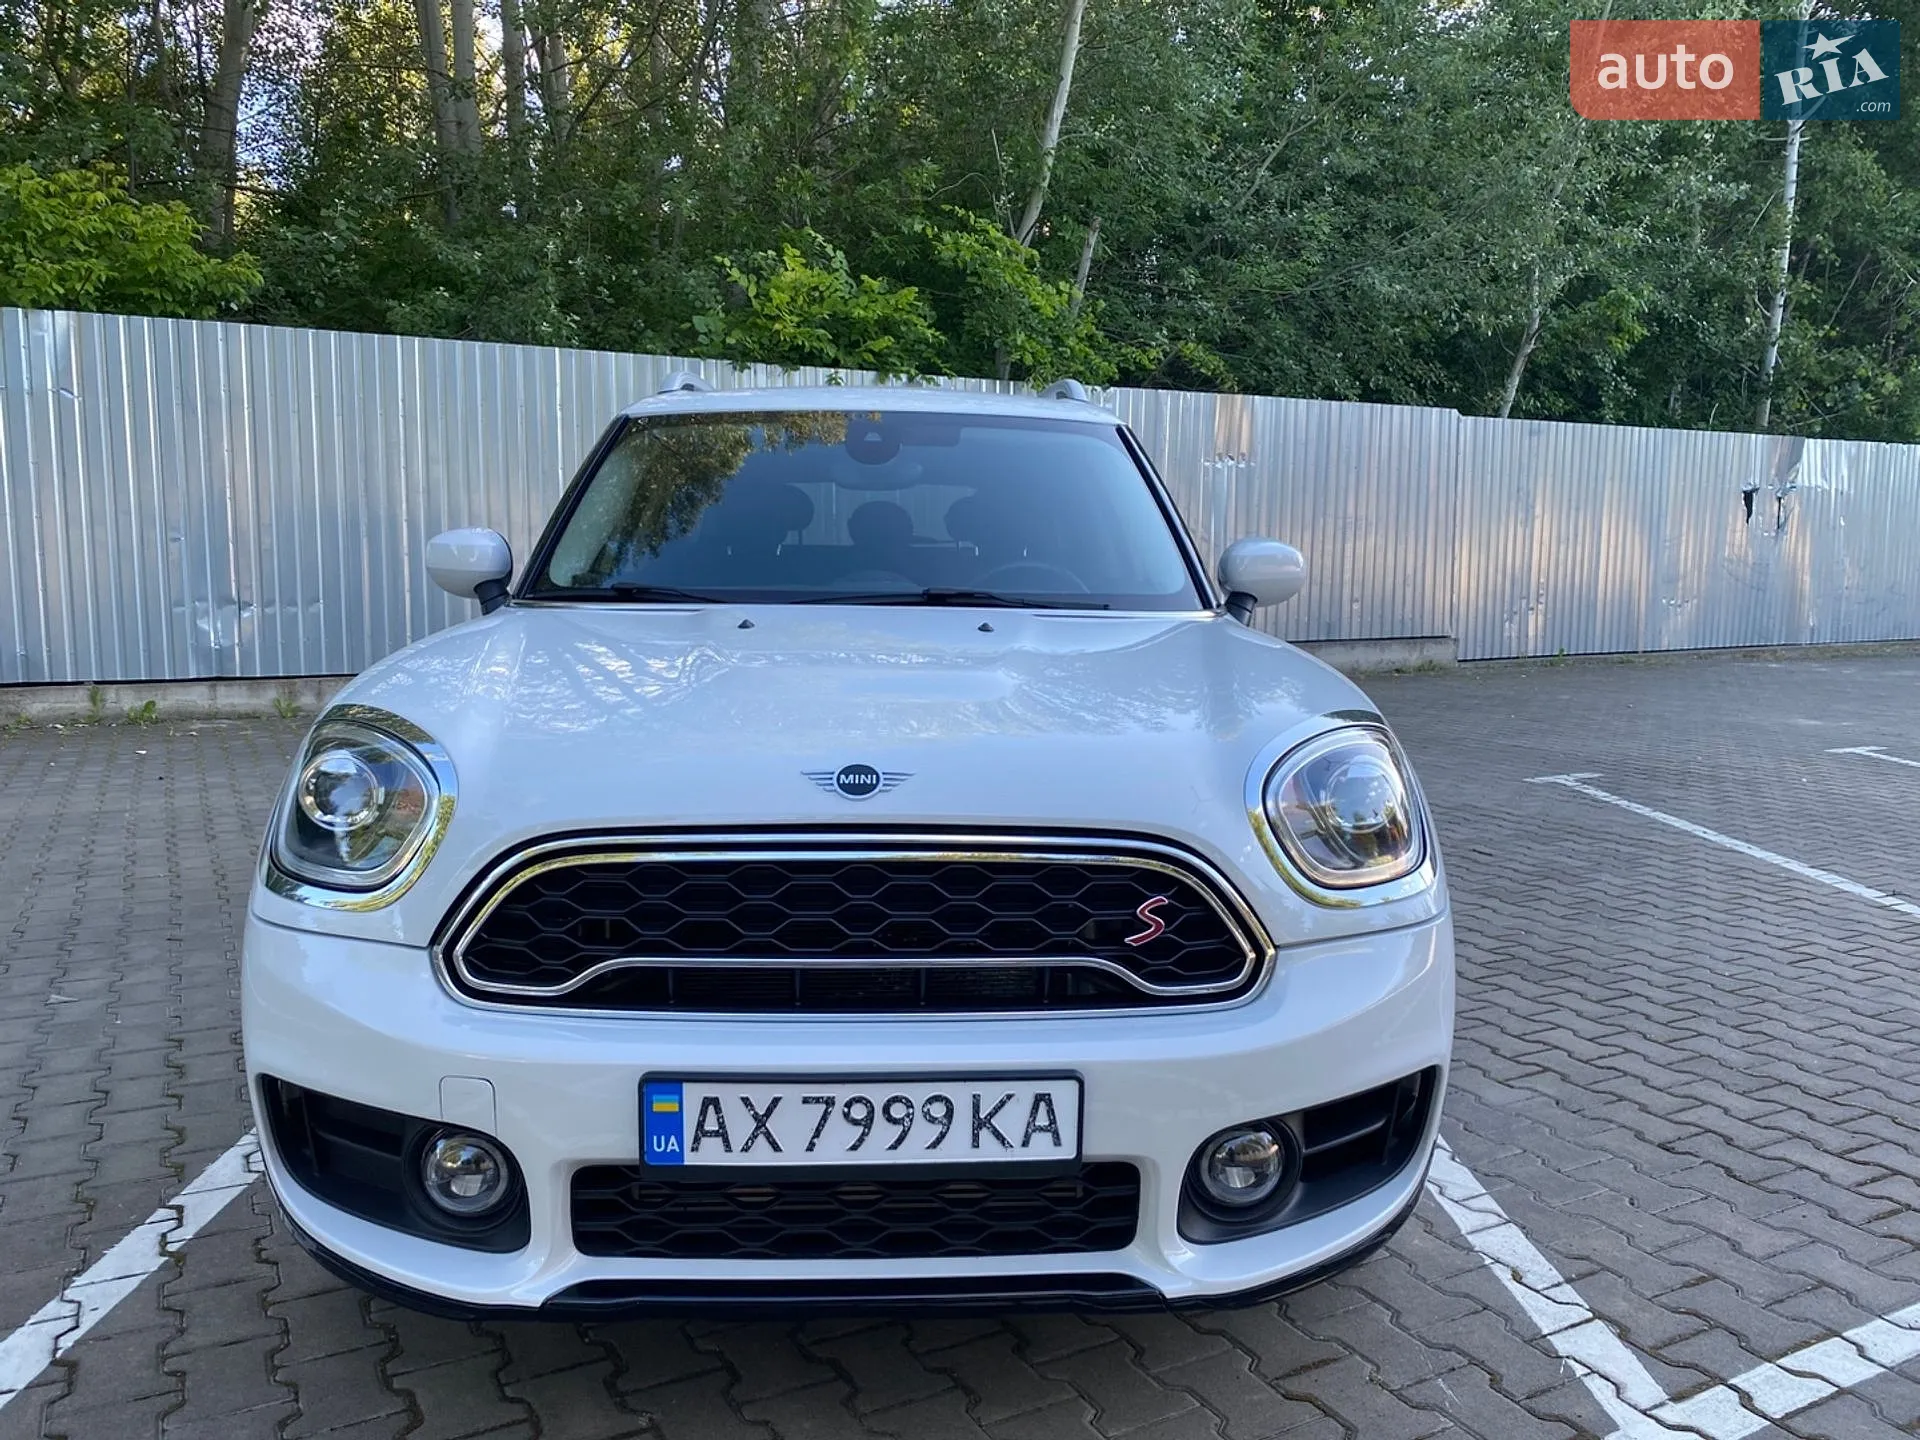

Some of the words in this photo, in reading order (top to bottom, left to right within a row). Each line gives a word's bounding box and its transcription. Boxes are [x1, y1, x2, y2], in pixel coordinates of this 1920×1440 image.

[839, 774, 877, 784] MINI
[1123, 895, 1168, 947] S
[689, 1095, 784, 1154] AX
[801, 1094, 955, 1152] 7999
[971, 1092, 1062, 1152] KA
[653, 1135, 680, 1153] UA
